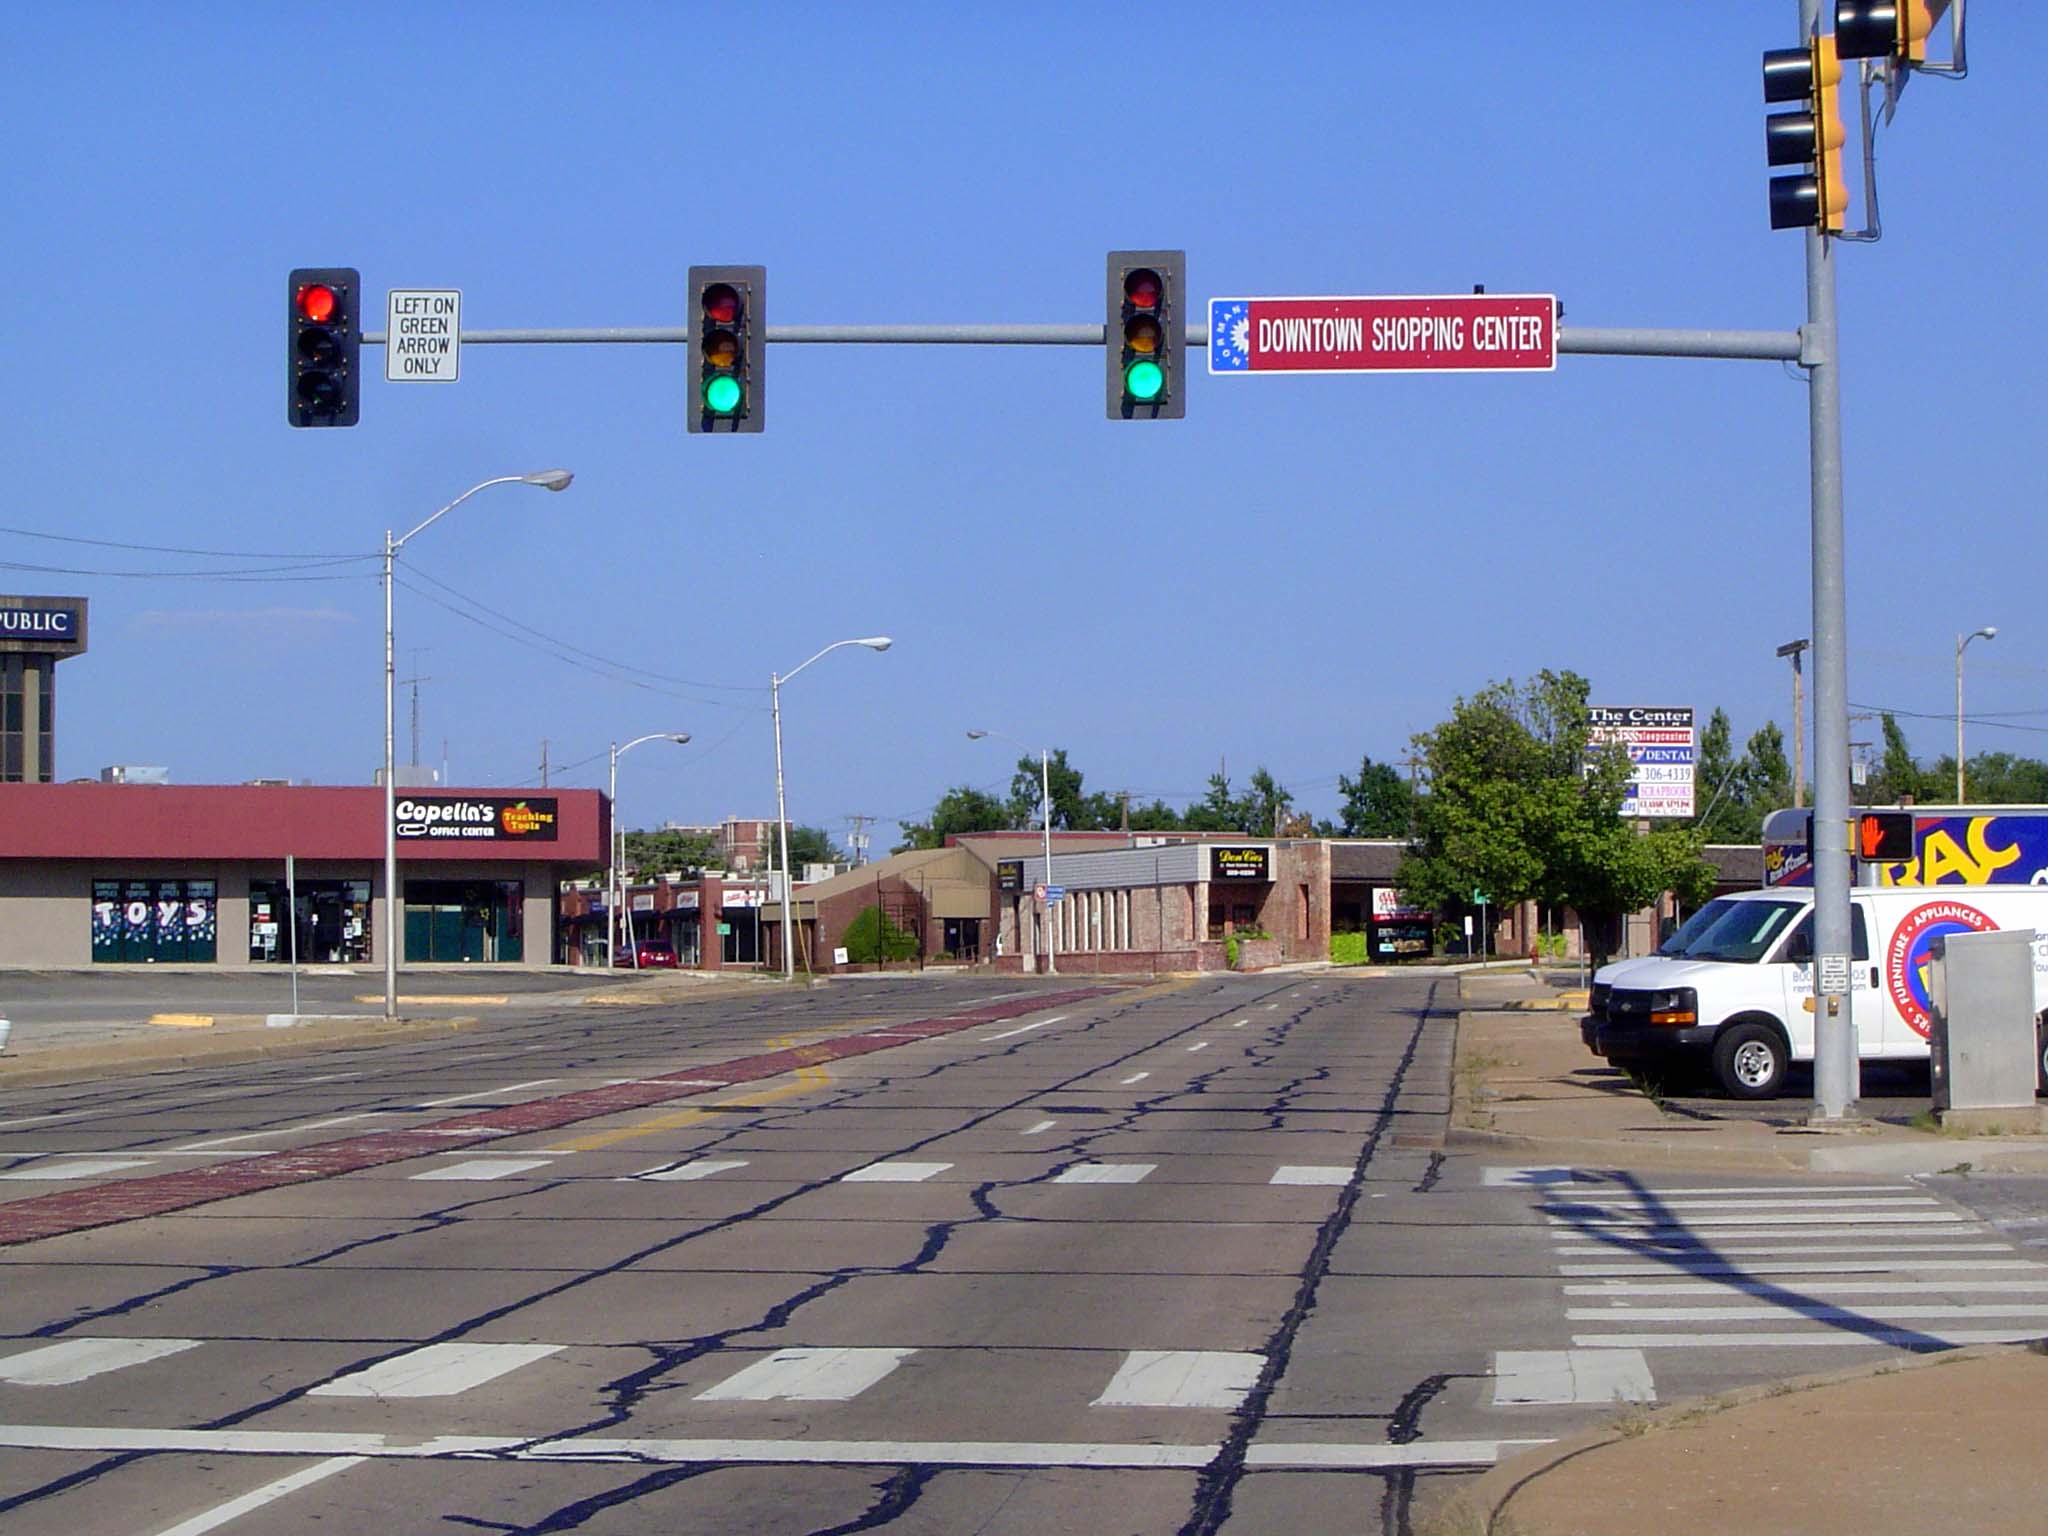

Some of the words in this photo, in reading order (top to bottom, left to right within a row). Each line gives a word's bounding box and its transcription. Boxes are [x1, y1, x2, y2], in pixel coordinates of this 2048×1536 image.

[395, 298, 430, 314] LEFT
[434, 298, 454, 314] ON
[400, 318, 447, 334] GREEN
[1259, 318, 1362, 352] DOWNTOWN
[1372, 316, 1464, 351] SHOPPING
[1472, 316, 1543, 350] CENTER
[396, 338, 449, 354] ARROW
[404, 357, 440, 374] ONLY
[1590, 709, 1624, 721] The
[1629, 709, 1691, 721] Center
[1646, 751, 1692, 760] DENTAL
[1645, 767, 1691, 780] 306-4339
[396, 801, 495, 824] Copelin's
[503, 812, 553, 823] Teaching
[430, 827, 460, 836] OFFICE
[462, 827, 495, 836] CENTER
[511, 821, 540, 830] Tools
[95, 901, 207, 926] TOYS
[1913, 906, 1984, 927] APPLIANCES
[1892, 933, 1910, 1005] FURNITURE
